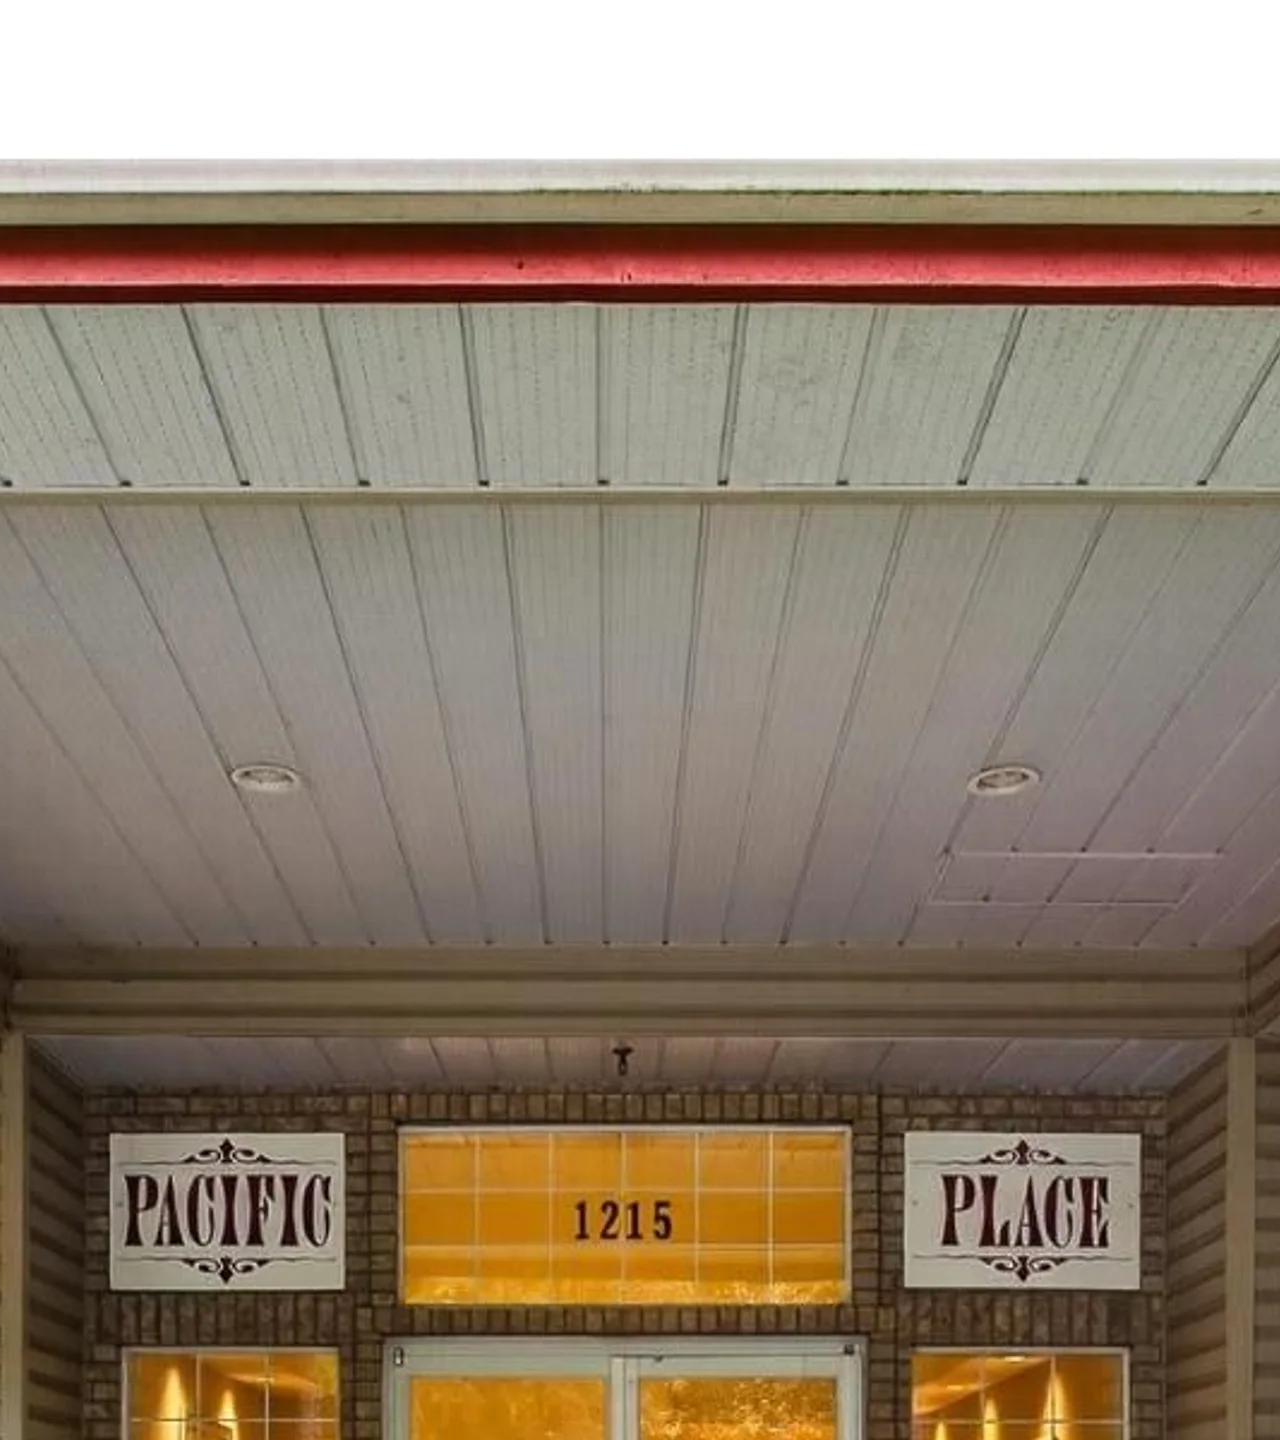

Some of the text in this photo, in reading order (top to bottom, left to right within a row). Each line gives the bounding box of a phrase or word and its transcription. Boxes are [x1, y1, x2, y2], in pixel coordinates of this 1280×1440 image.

[124, 1173, 332, 1247] PACIFIC
[574, 1200, 673, 1241] 1215
[941, 1173, 1109, 1249] PLACE
